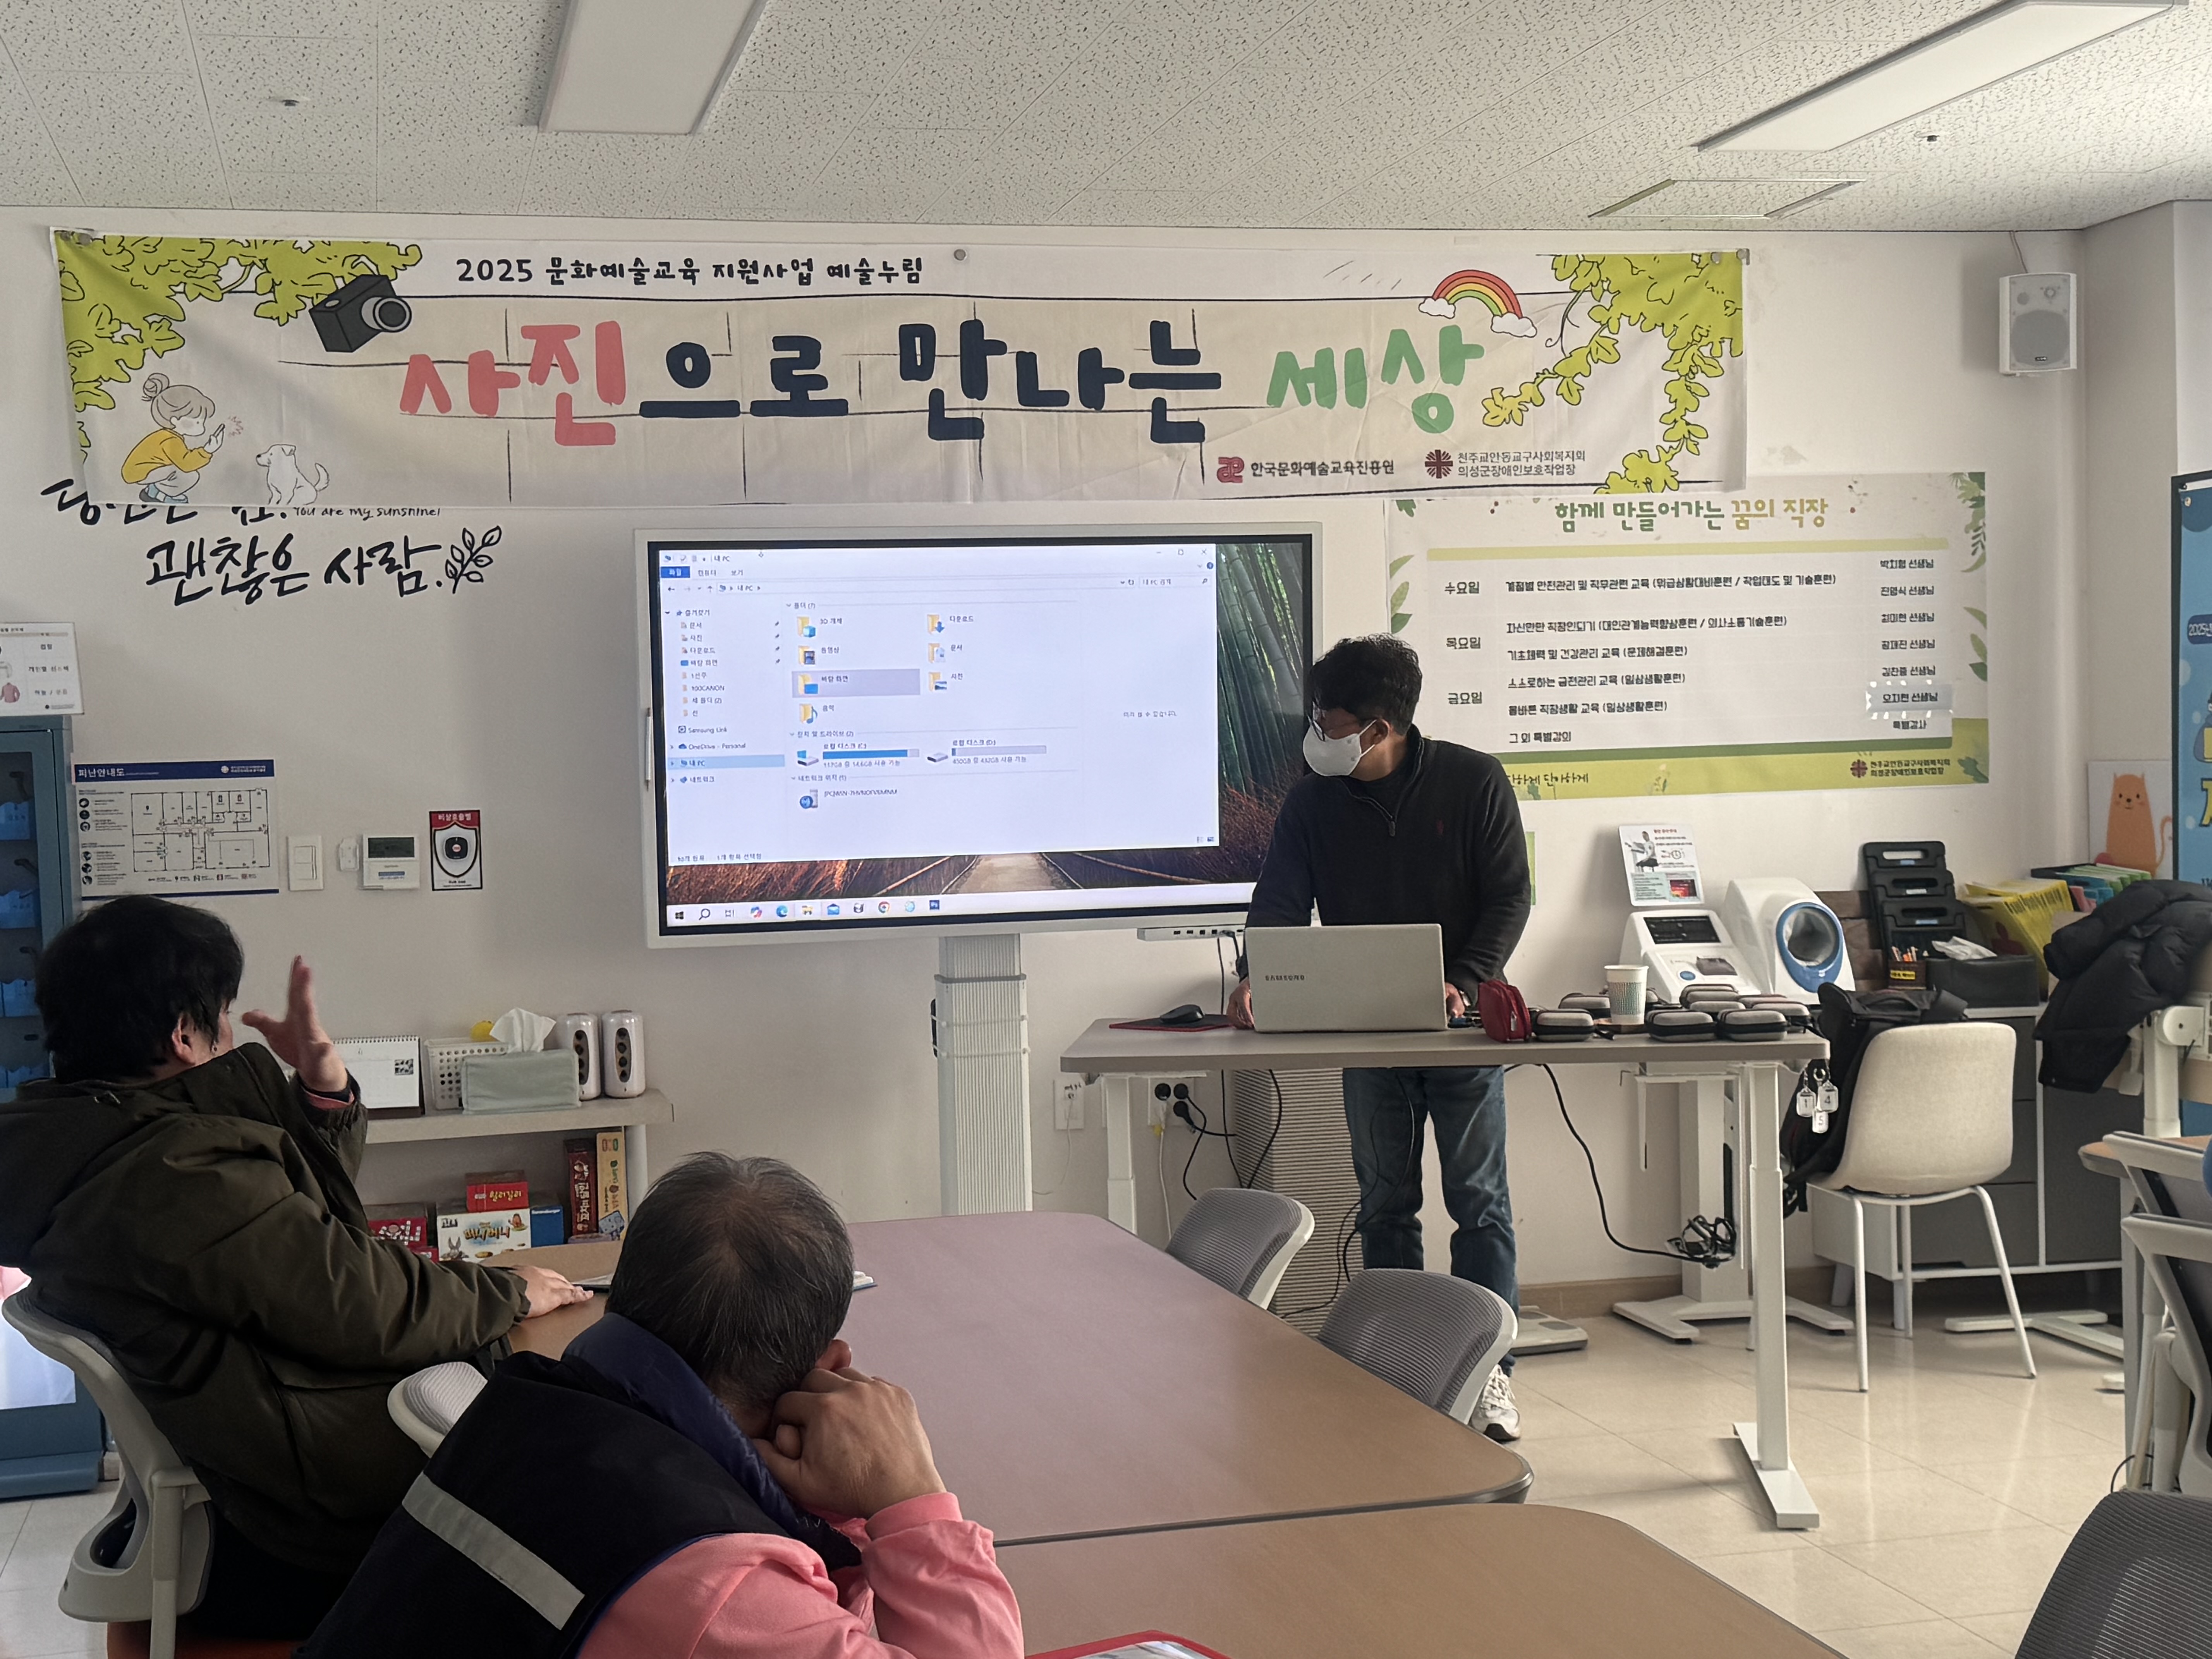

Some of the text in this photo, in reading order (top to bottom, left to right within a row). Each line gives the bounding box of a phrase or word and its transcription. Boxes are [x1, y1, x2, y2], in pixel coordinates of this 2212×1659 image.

[457, 256, 923, 286] 2025 문화예술교육 지원사업 예술누림
[399, 319, 1485, 446] 사진으로 만나는 세상
[1458, 450, 1585, 464] 천주교안동교구사회복지회
[1251, 460, 1394, 477] 한국문화예술교육진흥원
[1458, 464, 1575, 477] 의성군장애인보호작업장
[321, 508, 344, 516] are
[349, 508, 373, 521] my
[1554, 498, 1828, 533] 함께 만들어가는 꿈의 직장
[146, 533, 443, 606] 괜찮은 사람.
[1909, 559, 1934, 568] 선생님
[1444, 581, 1480, 594] 수요일
[1537, 580, 1575, 592] 안전관리
[1578, 580, 1587, 591] 및
[1590, 579, 1628, 591] 직무관련
[1631, 579, 1649, 589] 교육
[1783, 575, 1793, 586] 및
[1796, 574, 1836, 586] 기술훈련)
[1909, 586, 1934, 595] 선생님
[1909, 613, 1935, 622] 선생님
[1506, 622, 1544, 633] 자신만만
[1446, 637, 1481, 649] 목요일
[1910, 639, 1935, 649] 선생님
[1508, 649, 1546, 660] 기초체력
[1548, 649, 1557, 659] 및
[1561, 648, 1598, 659] 건강관리
[1601, 647, 1619, 658] 교육
[1910, 665, 1936, 676] 선생님
[1508, 677, 1555, 688] 스스로하는
[1558, 675, 1595, 687] 금전관리
[1599, 675, 1617, 686] 교육
[1448, 692, 1482, 704] 금요일
[1911, 692, 1938, 702] 선생님
[1540, 704, 1578, 715] 직장생활
[1581, 703, 1599, 714] 교육
[1510, 733, 1518, 743] 그
[79, 768, 125, 778] 피난안내도
